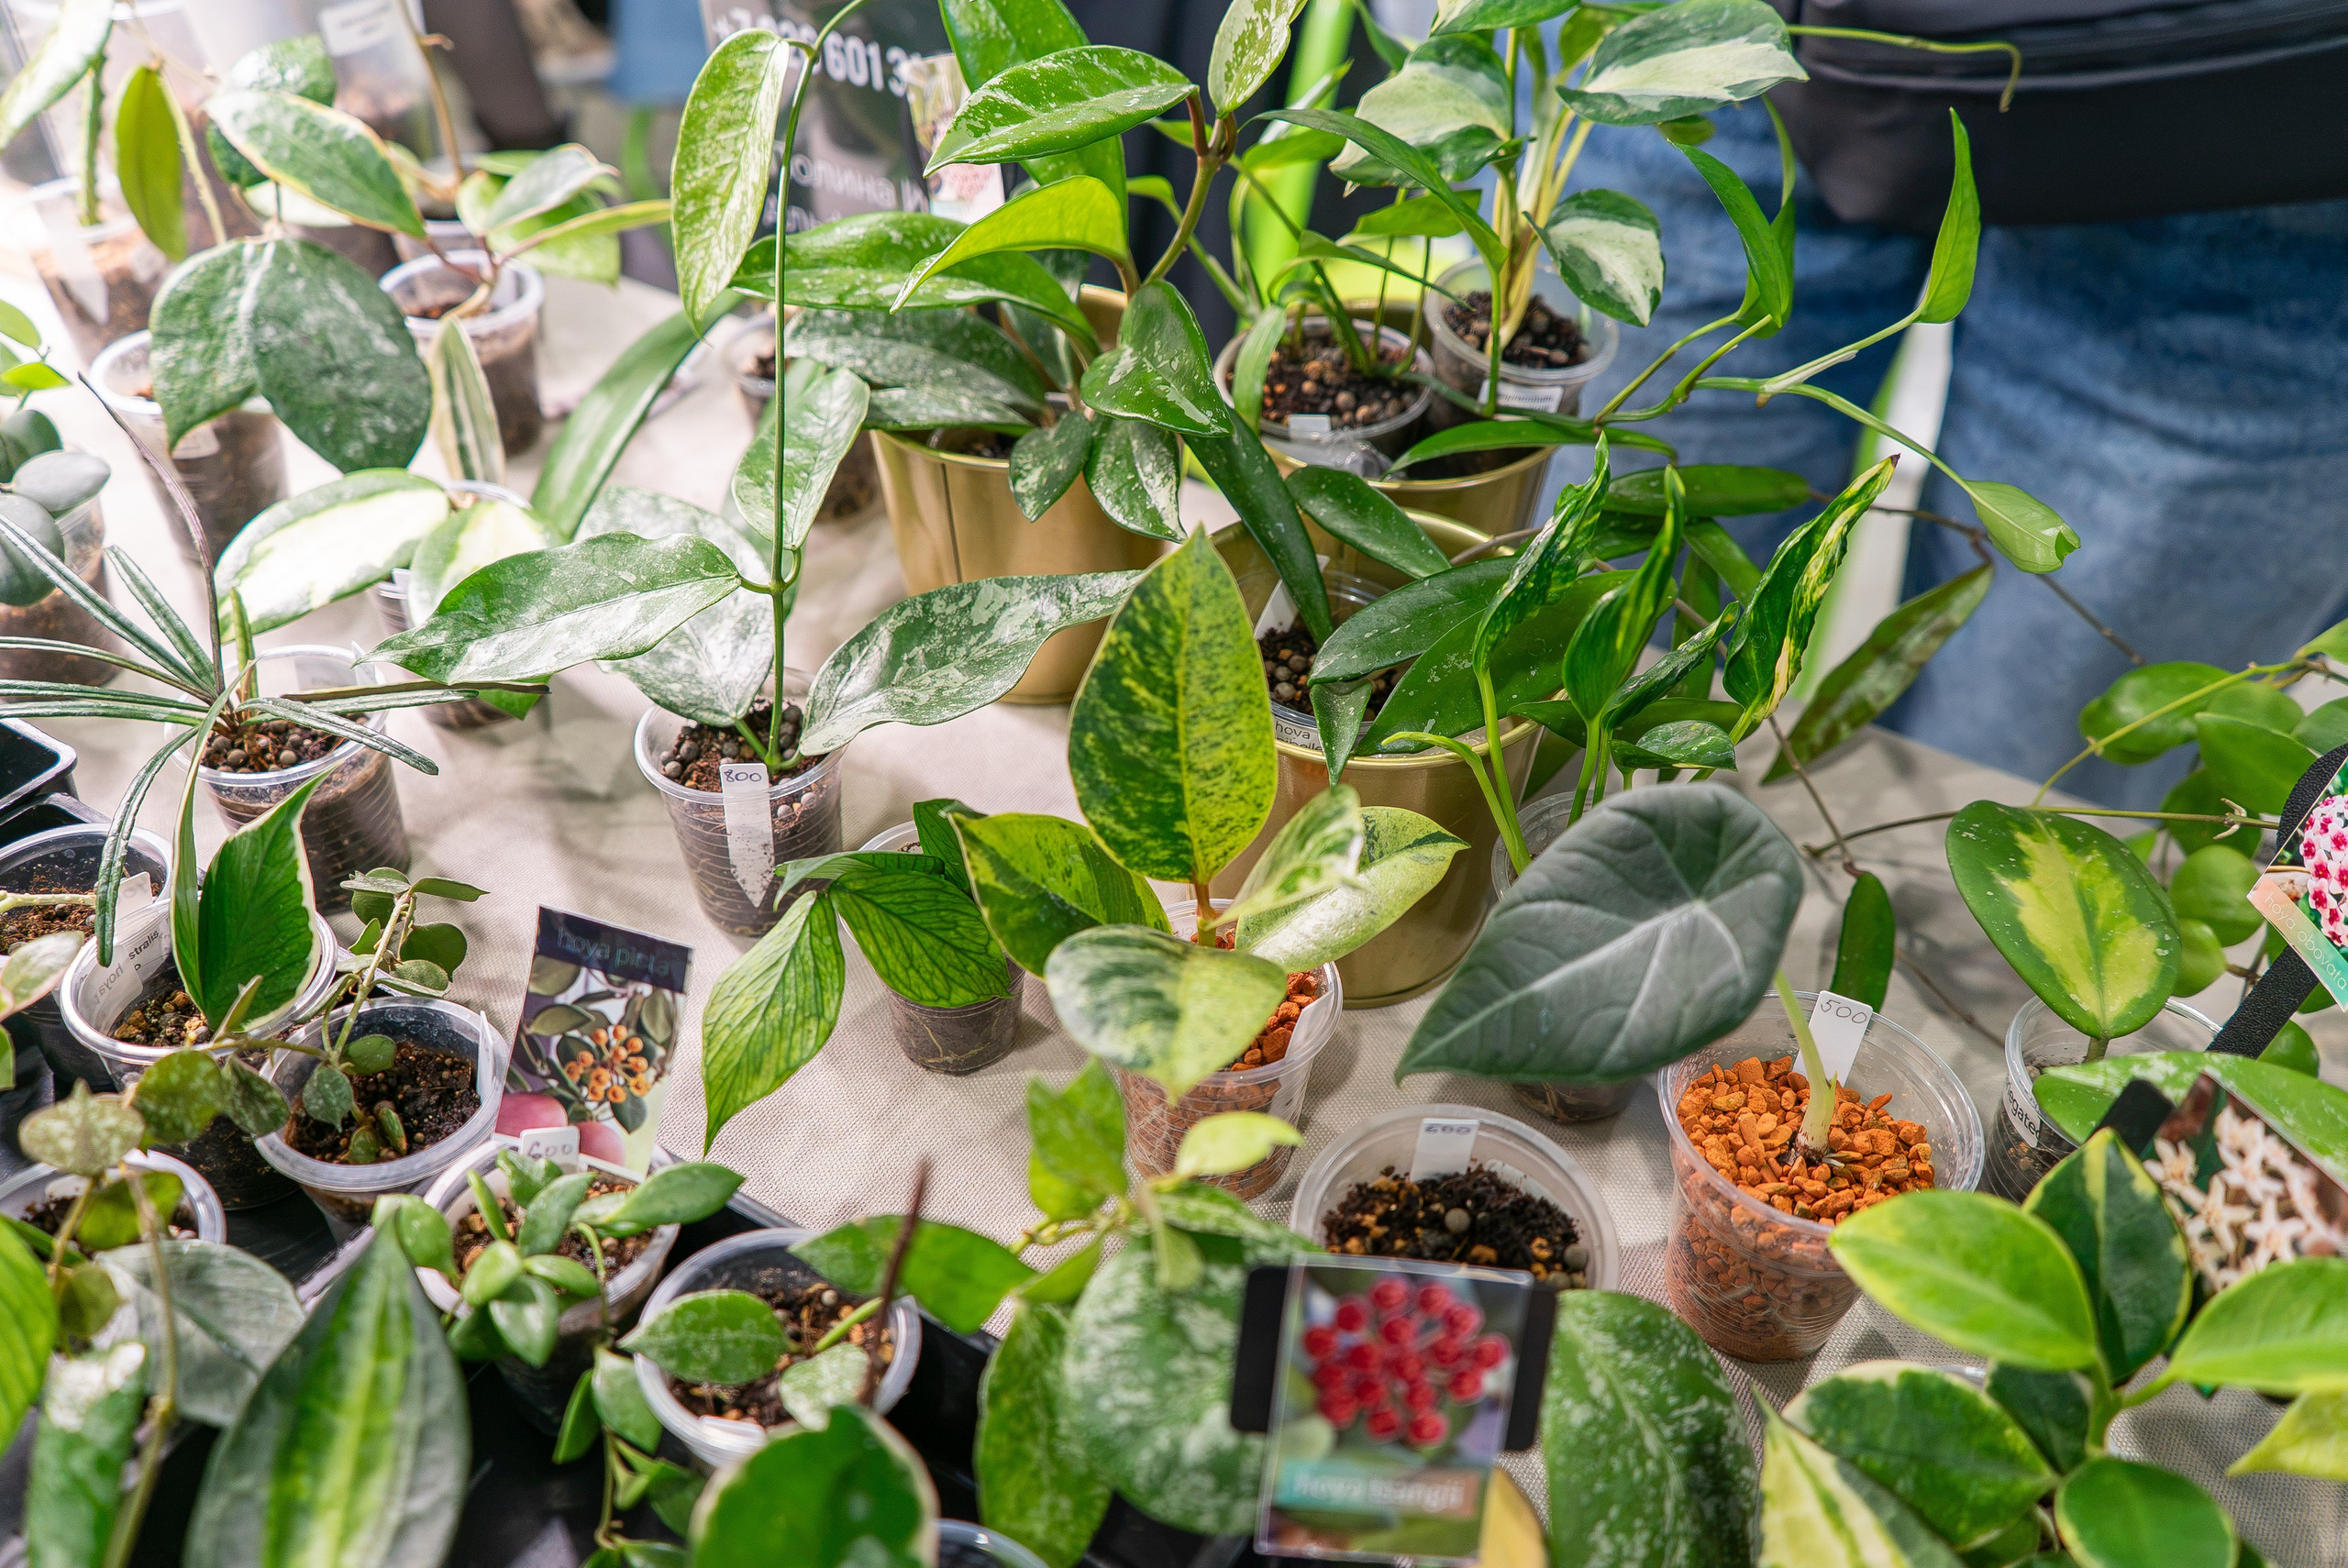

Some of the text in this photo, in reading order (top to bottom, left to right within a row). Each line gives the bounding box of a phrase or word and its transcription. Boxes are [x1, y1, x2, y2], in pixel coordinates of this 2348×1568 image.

[824, 29, 883, 92] 601
[724, 769, 762, 782] 800
[127, 930, 160, 960] stralis
[557, 925, 610, 959] hoya
[2264, 892, 2347, 990] hoya obovata
[1821, 999, 1867, 1023] 500
[527, 1141, 574, 1159] 600
